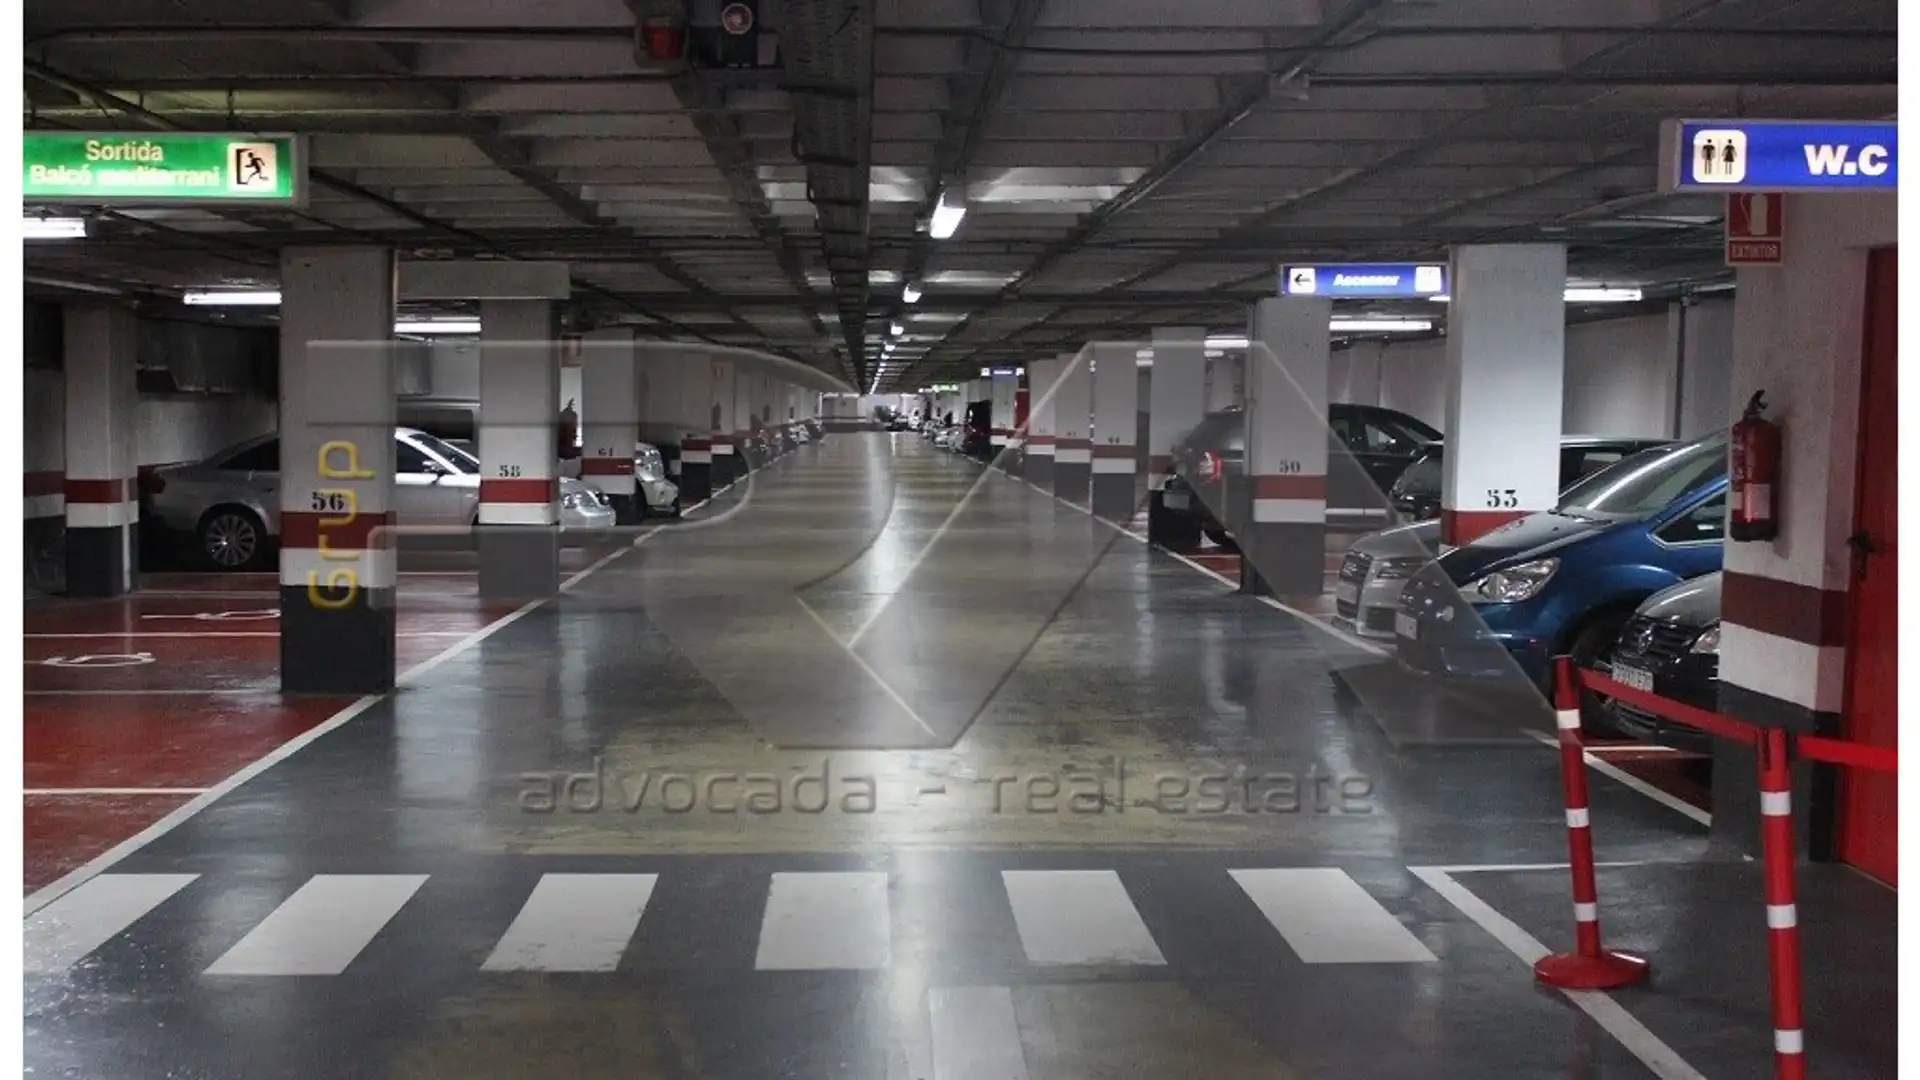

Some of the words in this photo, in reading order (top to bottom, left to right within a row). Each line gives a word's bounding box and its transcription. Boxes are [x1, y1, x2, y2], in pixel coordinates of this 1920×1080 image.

[84, 140, 164, 162] Sortida
[1803, 144, 1888, 176] W.C
[29, 164, 92, 186] Balcó
[311, 490, 345, 512] 56
[1486, 489, 1518, 508] 53
